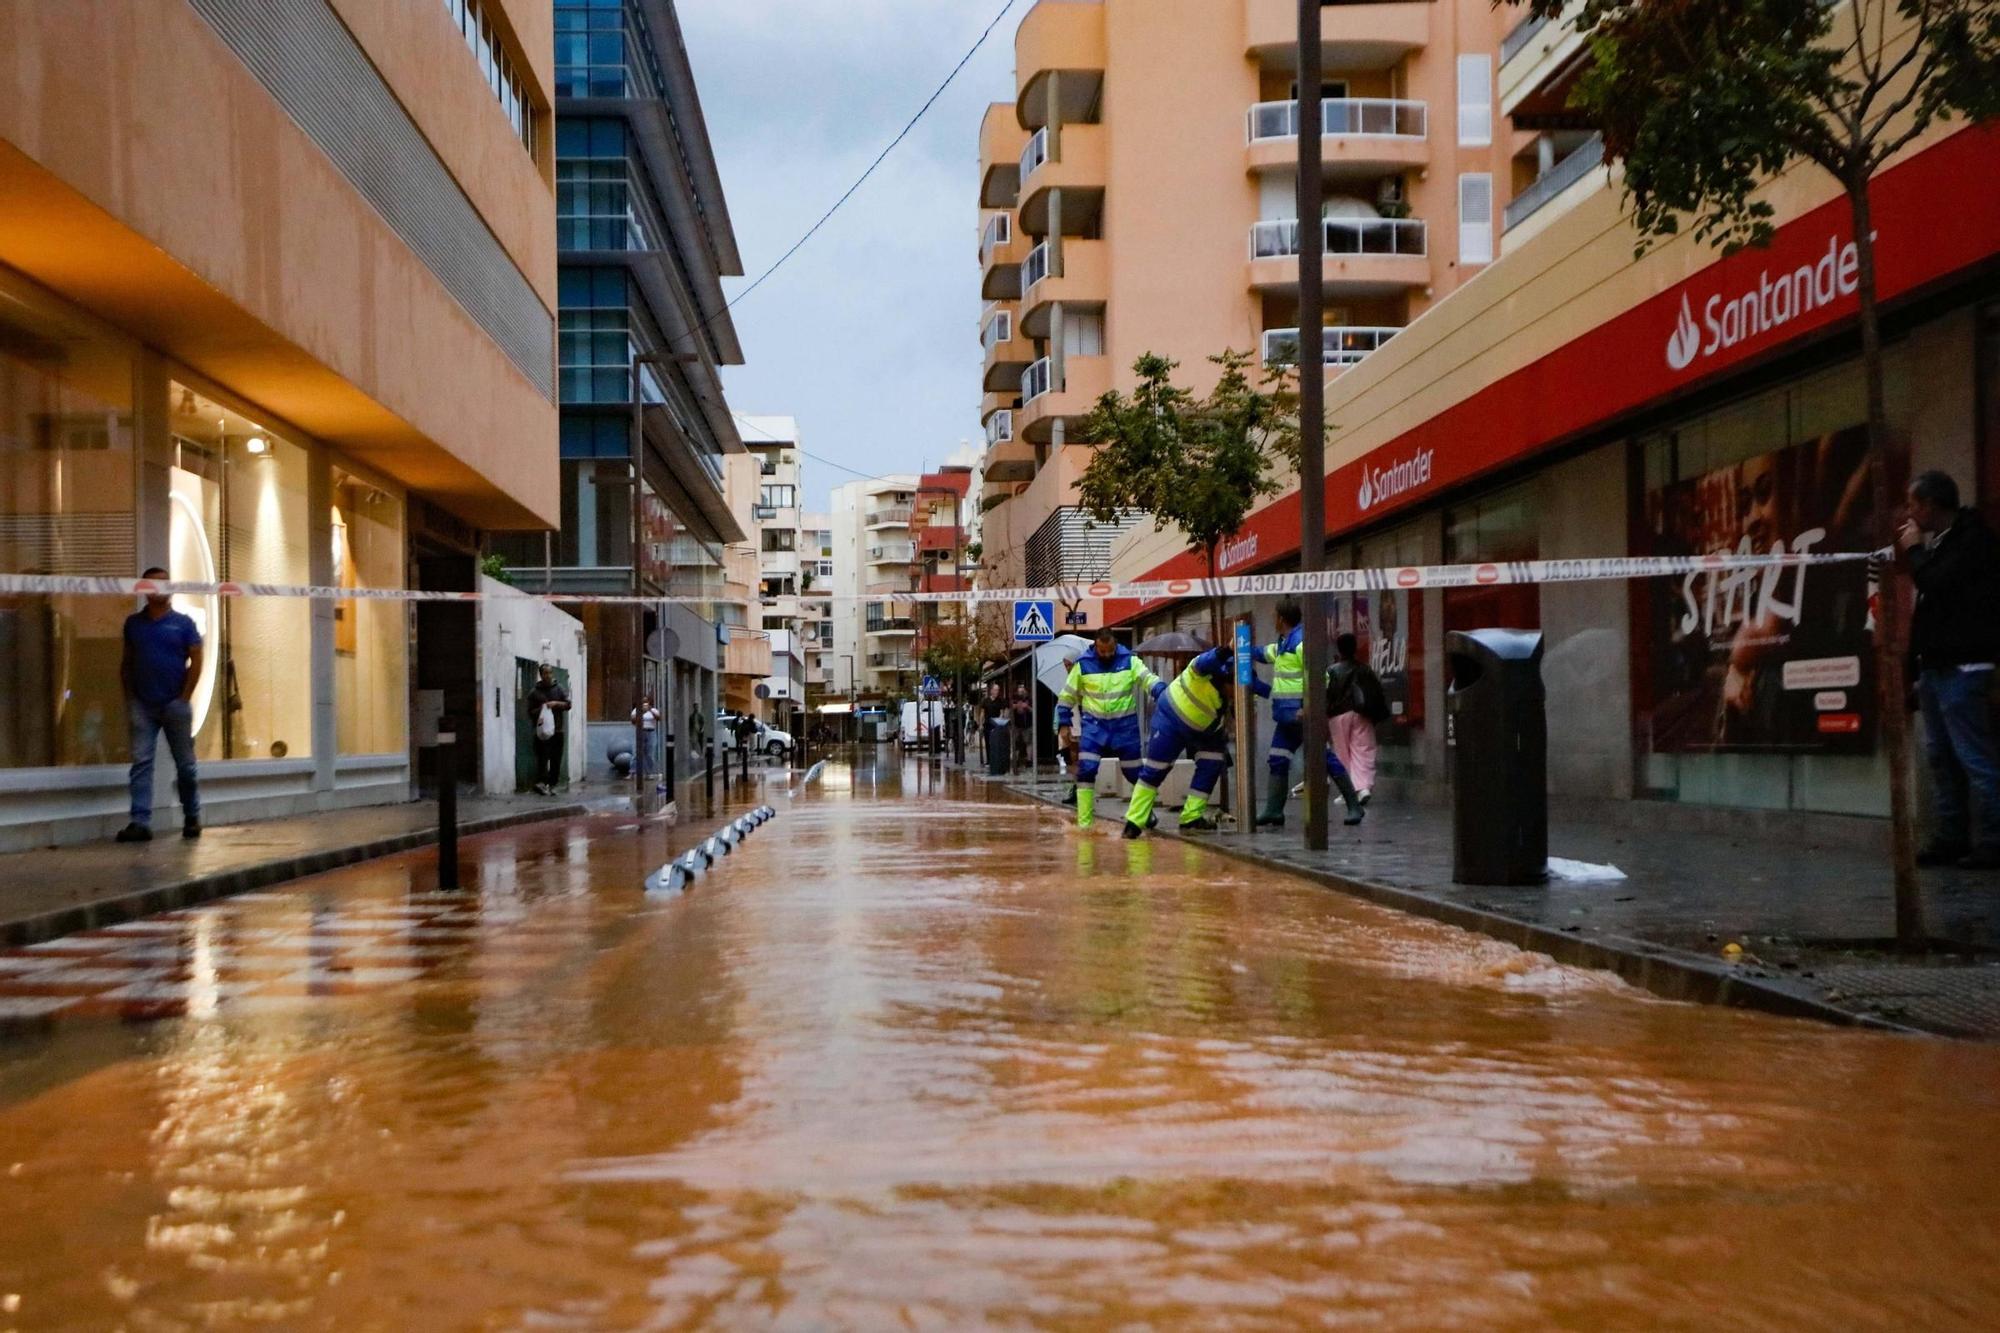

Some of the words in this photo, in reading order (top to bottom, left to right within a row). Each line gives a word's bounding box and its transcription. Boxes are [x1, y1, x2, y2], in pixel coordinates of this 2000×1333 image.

[1703, 231, 1878, 357] Santande
[1372, 447, 1434, 504] Santander
[1227, 530, 1258, 567] Santander
[1681, 527, 1826, 637] START
